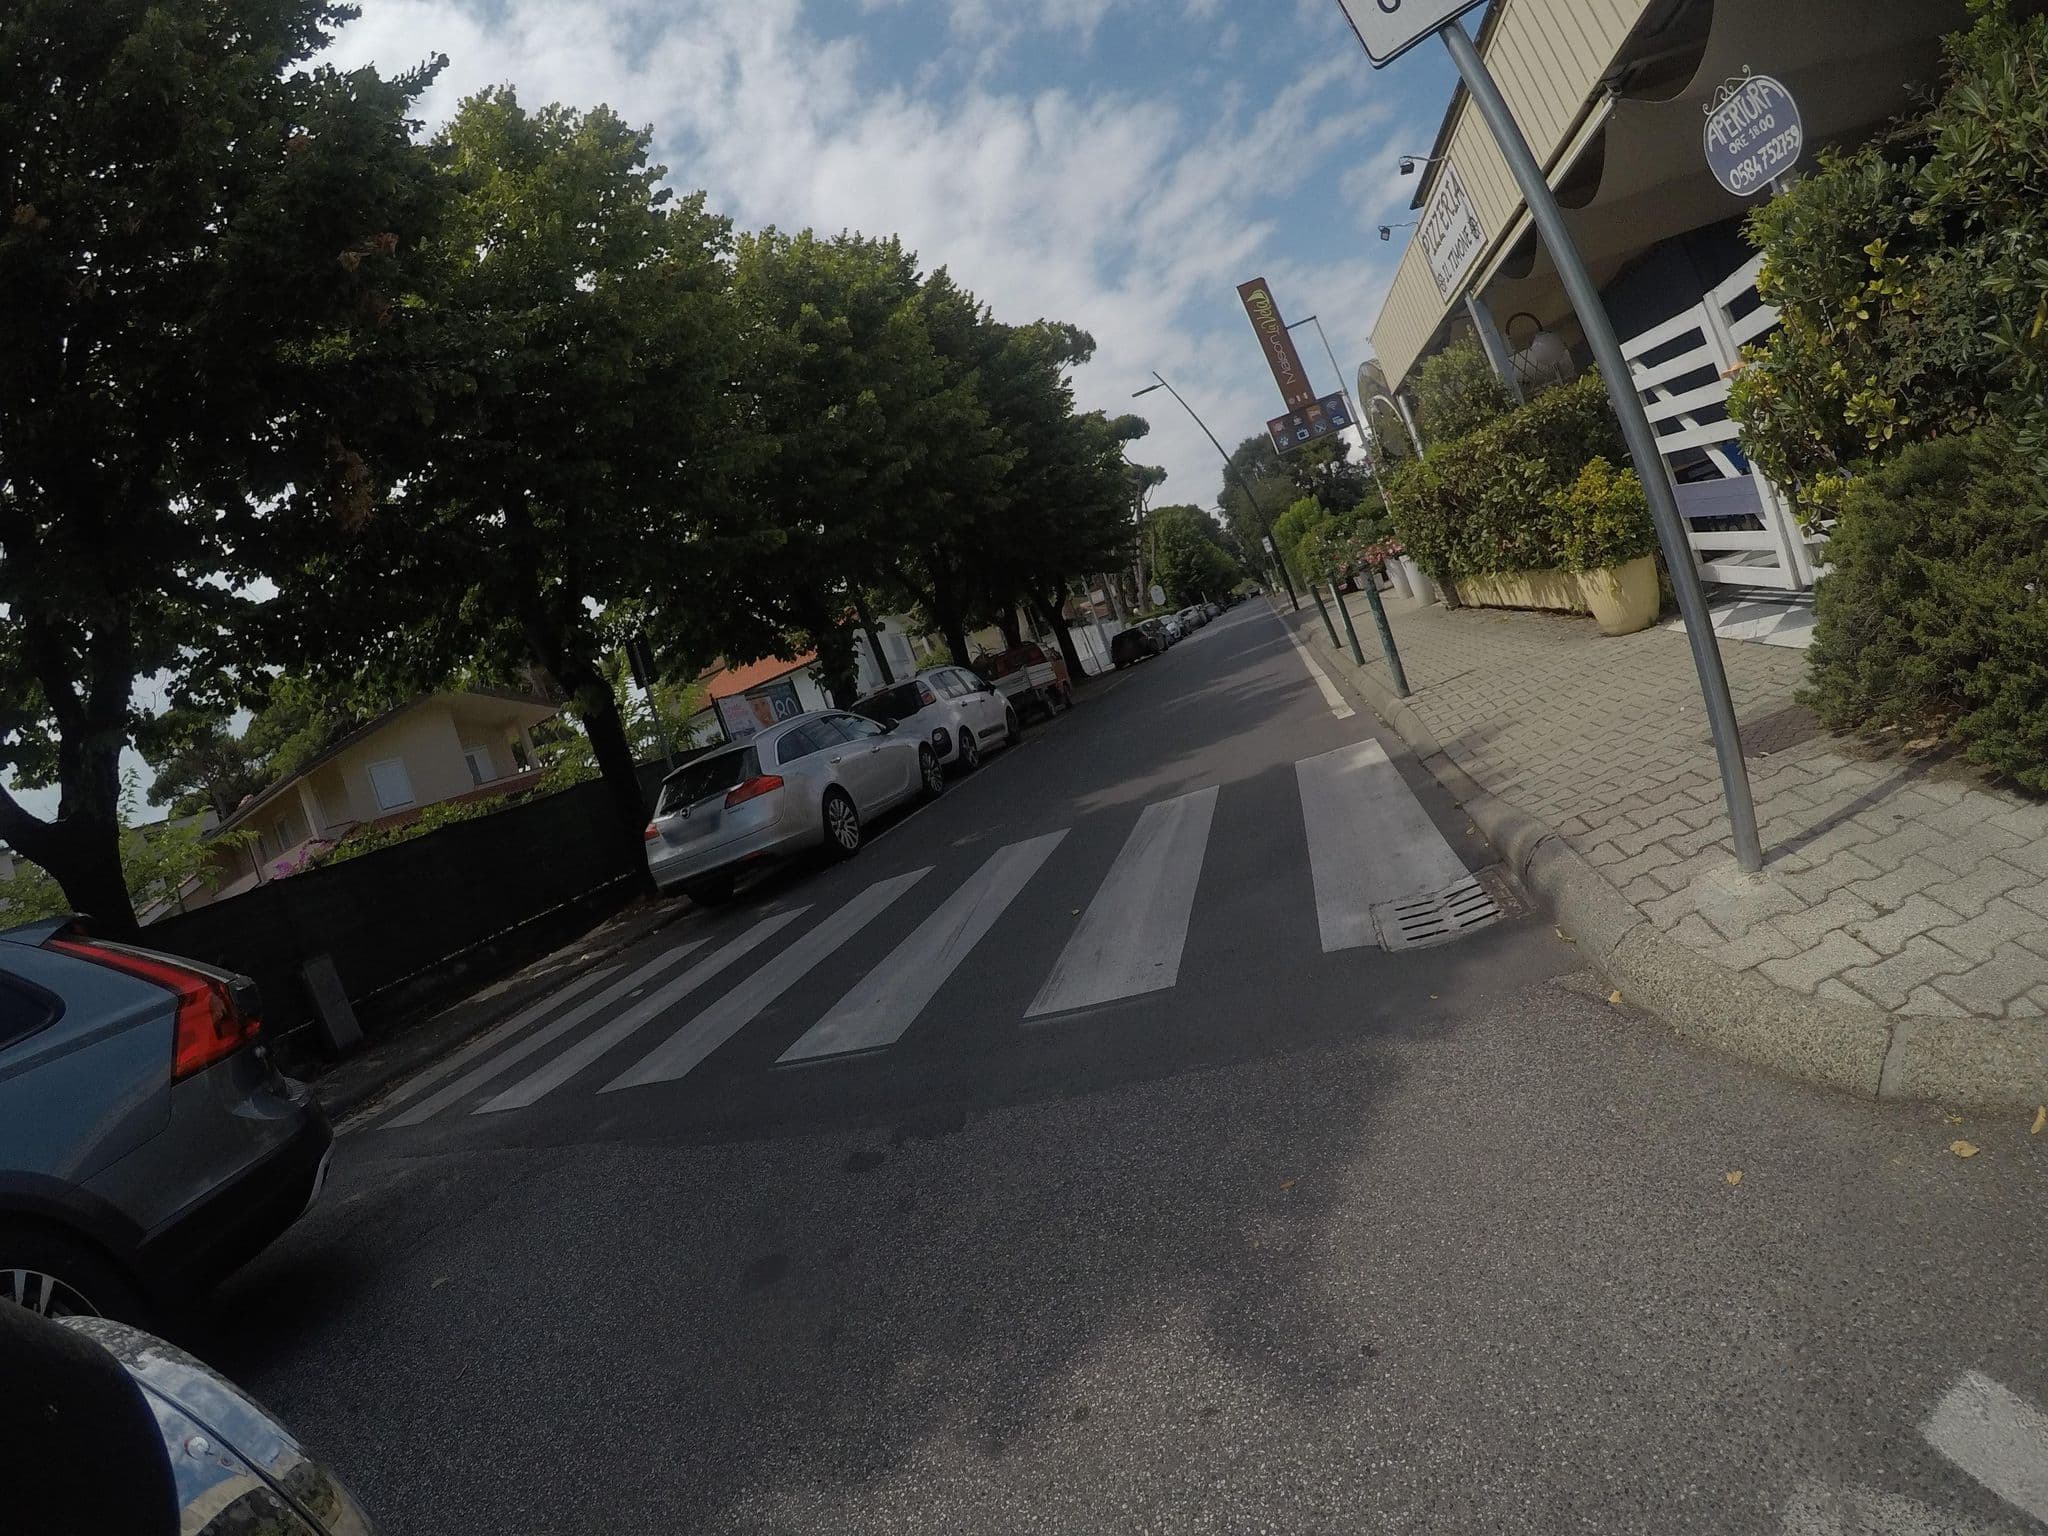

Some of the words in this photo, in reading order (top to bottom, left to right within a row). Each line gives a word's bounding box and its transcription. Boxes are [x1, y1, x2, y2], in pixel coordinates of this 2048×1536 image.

[1707, 79, 1784, 152] APERTURA
[1728, 133, 1749, 155] ORE
[1748, 113, 1775, 139] 18.00
[1729, 155, 1762, 189] 0584
[1757, 124, 1800, 170] 752759
[1419, 170, 1465, 264] PIZZERIA
[1441, 264, 1453, 282] IL
[1447, 225, 1474, 271] TIMONE
[1269, 334, 1297, 386] Maison
